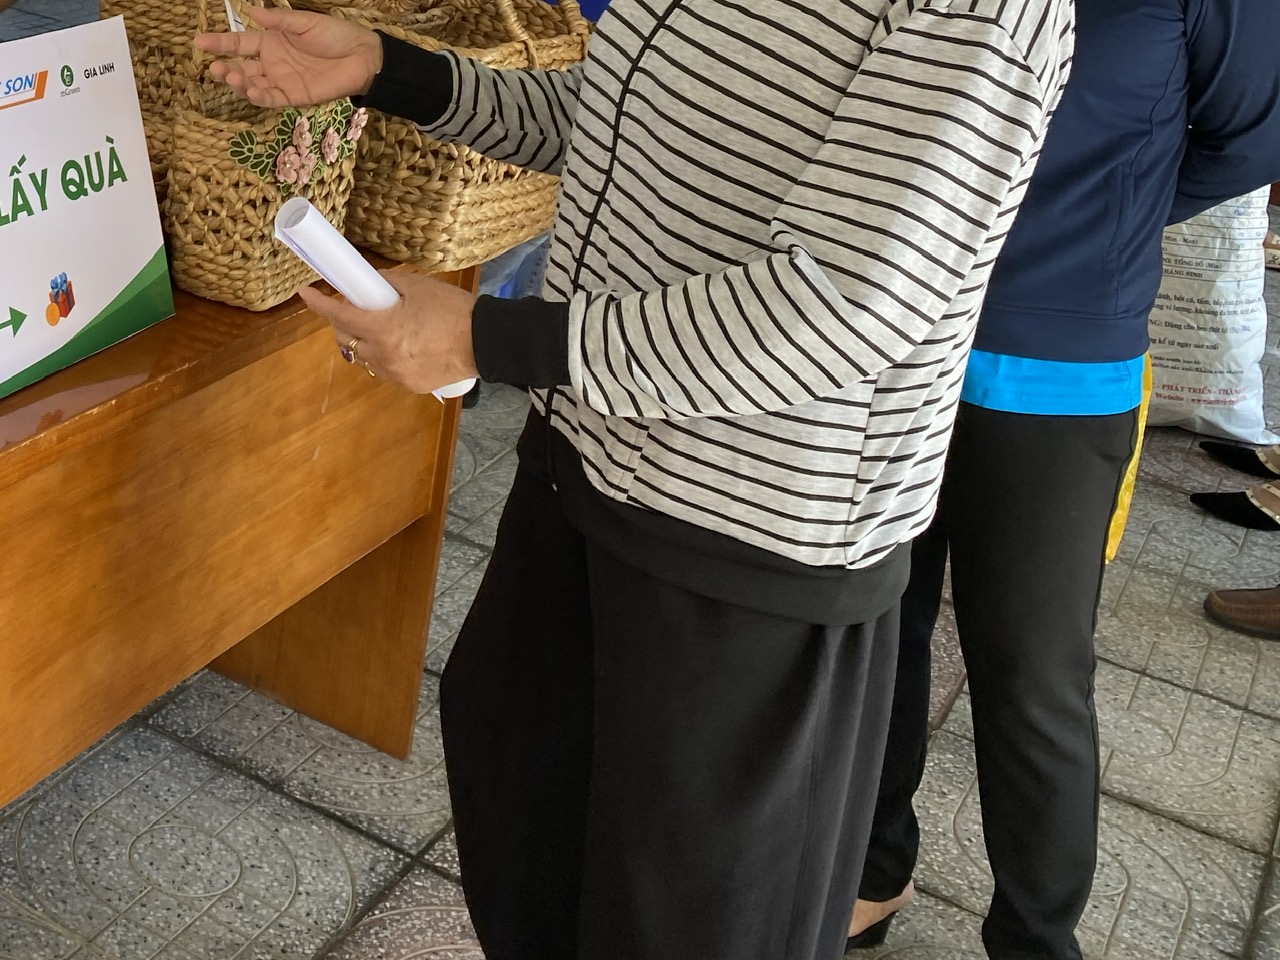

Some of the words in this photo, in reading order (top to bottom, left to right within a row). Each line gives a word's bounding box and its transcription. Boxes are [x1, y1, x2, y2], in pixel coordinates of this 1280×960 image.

[83, 67, 98, 80] GIA
[99, 62, 115, 76] LINH
[4, 73, 35, 95] SON
[60, 86, 81, 98] mGreen
[59, 135, 129, 203] QUÀ
[1164, 321, 1182, 330] Dùng
